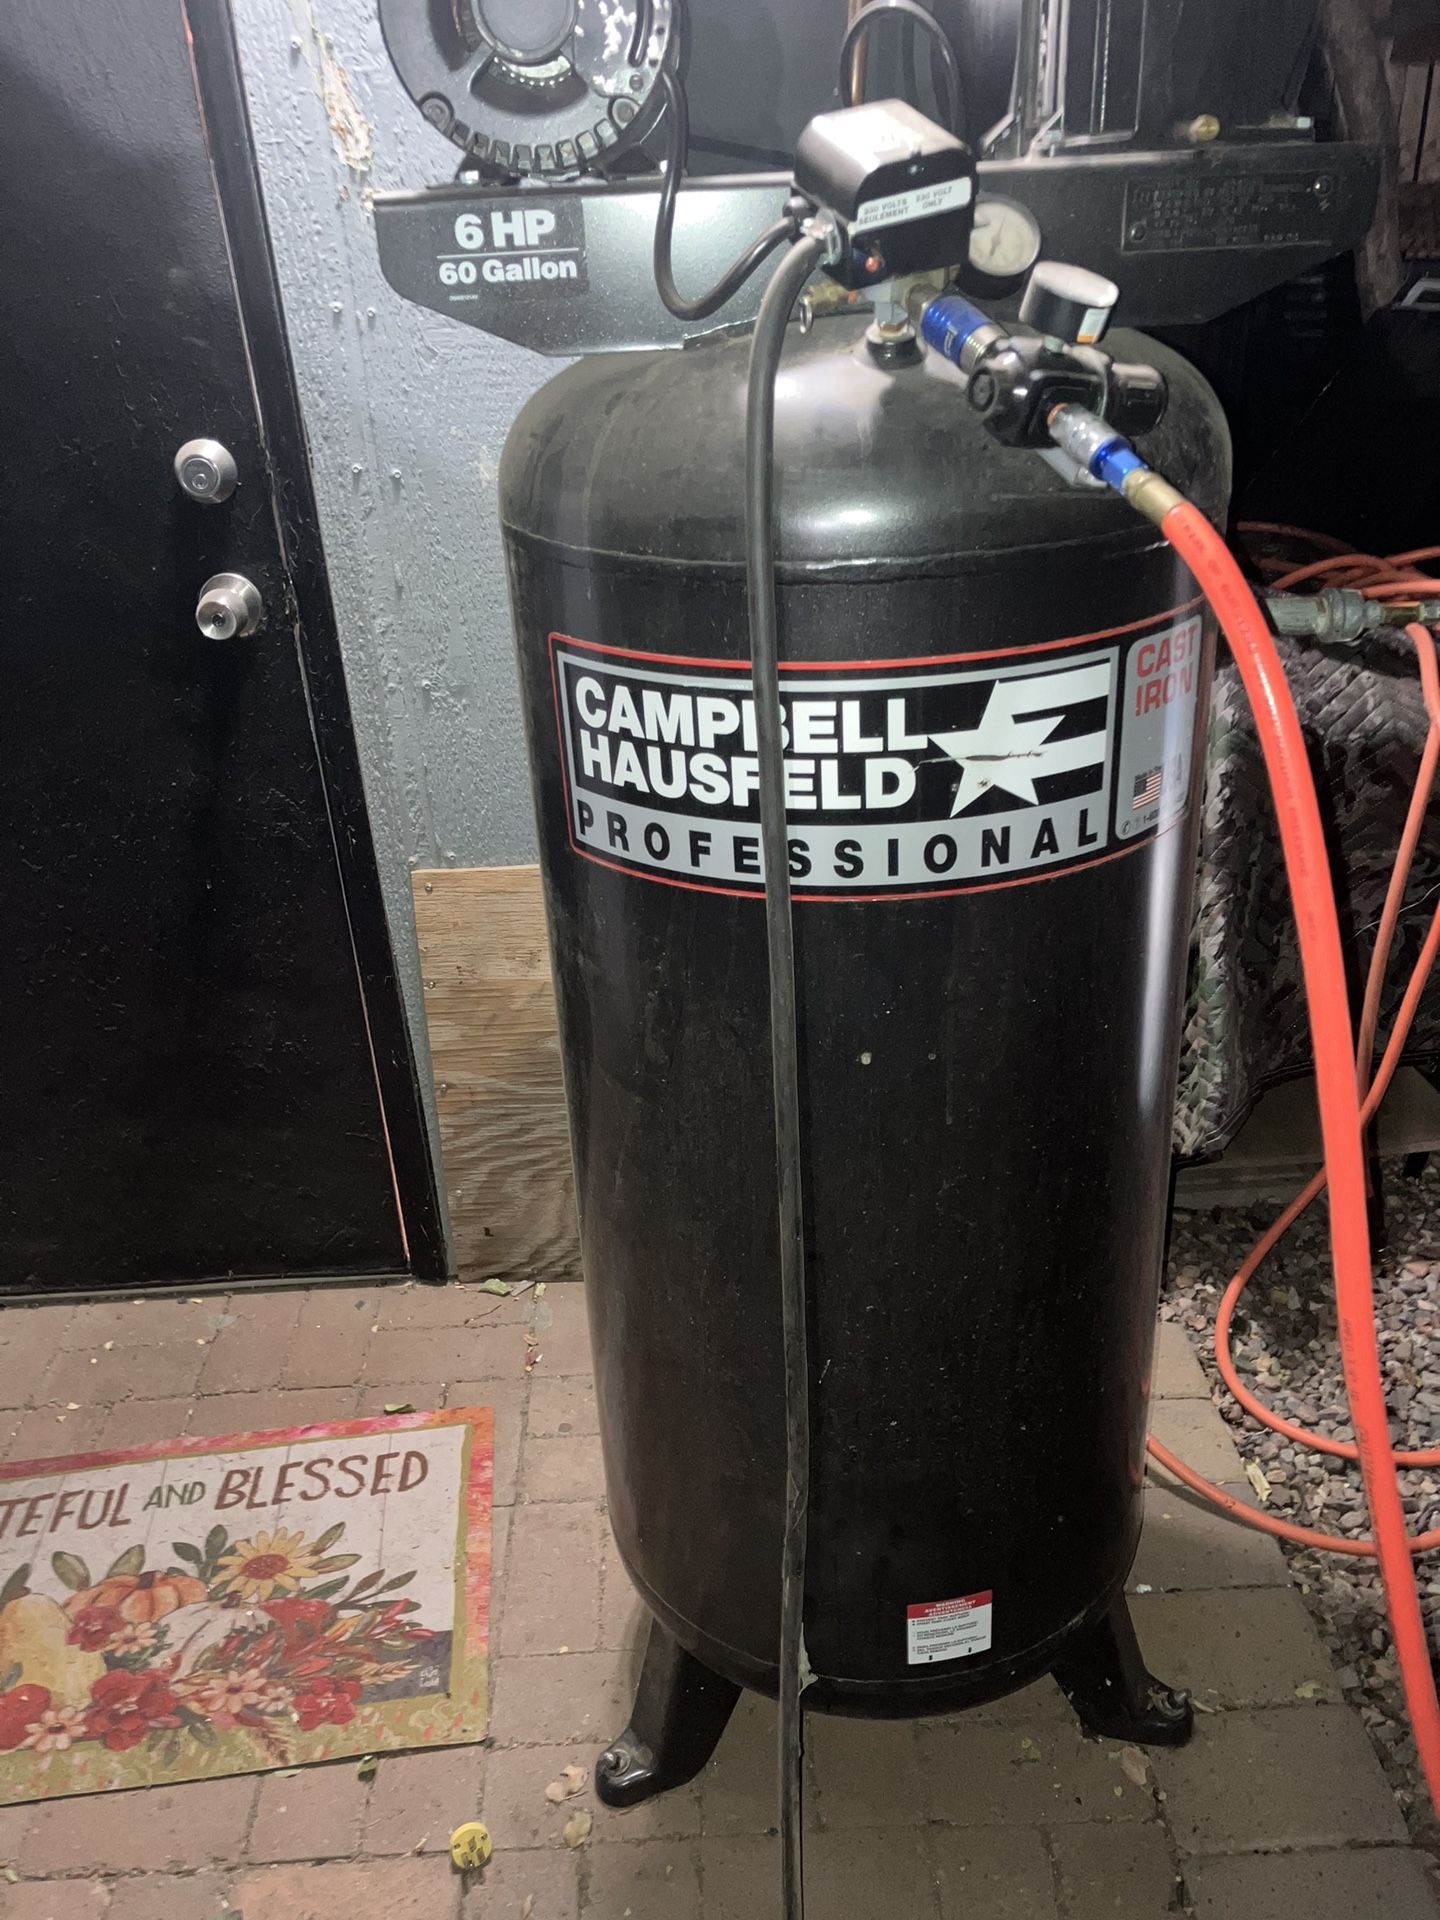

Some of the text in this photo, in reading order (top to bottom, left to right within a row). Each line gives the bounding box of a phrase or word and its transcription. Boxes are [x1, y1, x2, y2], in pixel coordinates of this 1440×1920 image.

[860, 207, 909, 224] SEULEMENT
[881, 199, 907, 211] VOLTS
[922, 198, 943, 209] ONLY
[454, 209, 555, 249] 6 HP
[439, 257, 578, 285] 60 Gallon
[1136, 623, 1198, 677] CAST
[1135, 662, 1193, 716] IRON
[580, 728, 916, 810] HAUSFELD
[577, 799, 1098, 878] PROFESSIONAL
[142, 1481, 206, 1511] AND
[214, 1451, 428, 1510] BLESSED
